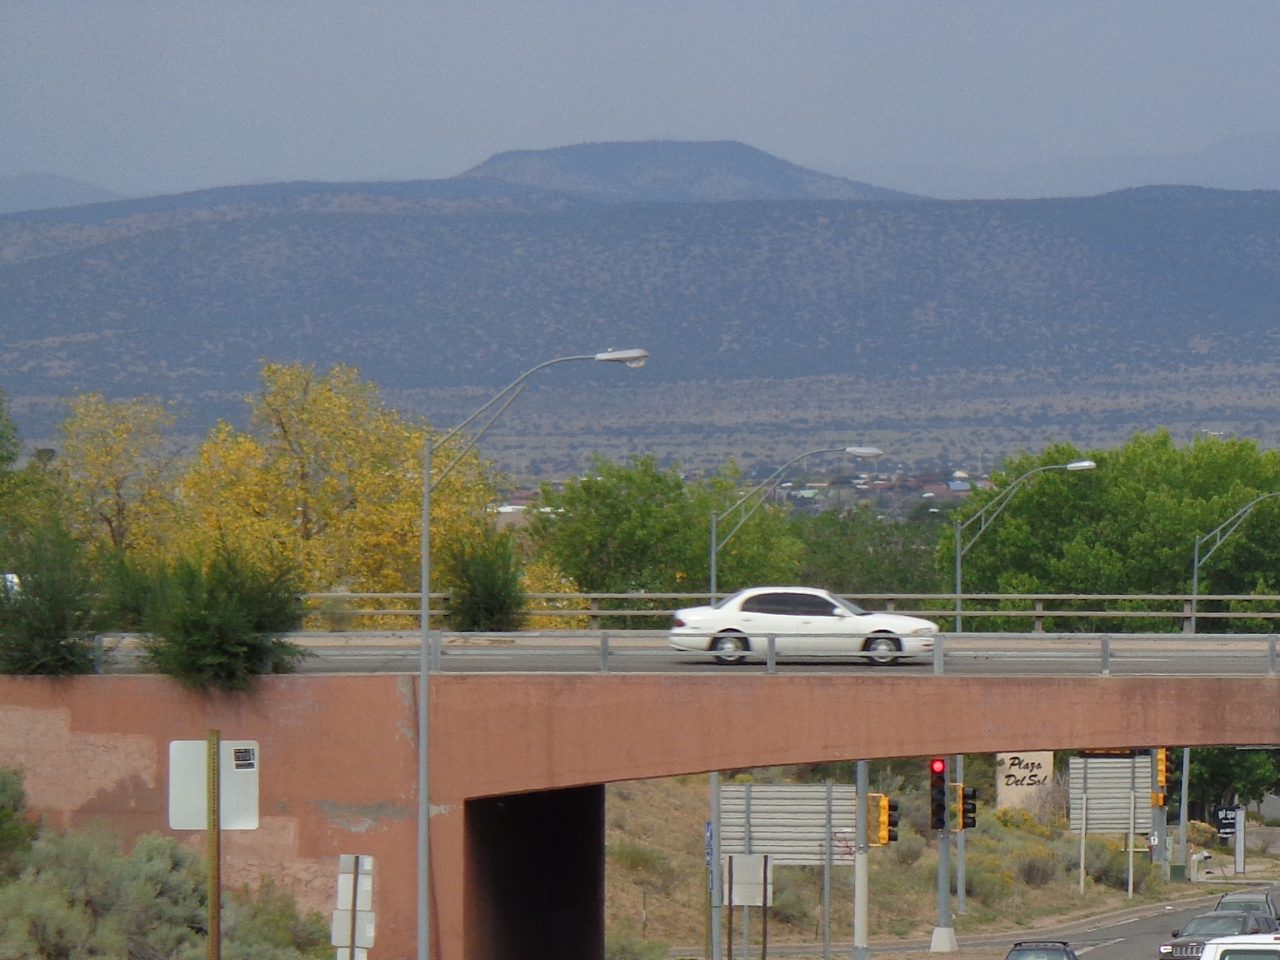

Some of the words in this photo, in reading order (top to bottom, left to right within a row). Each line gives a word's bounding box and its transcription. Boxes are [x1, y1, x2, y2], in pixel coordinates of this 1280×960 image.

[1008, 756, 1042, 773] Plaza
[1005, 774, 1026, 786] Del
[1026, 774, 1048, 786] Sol
